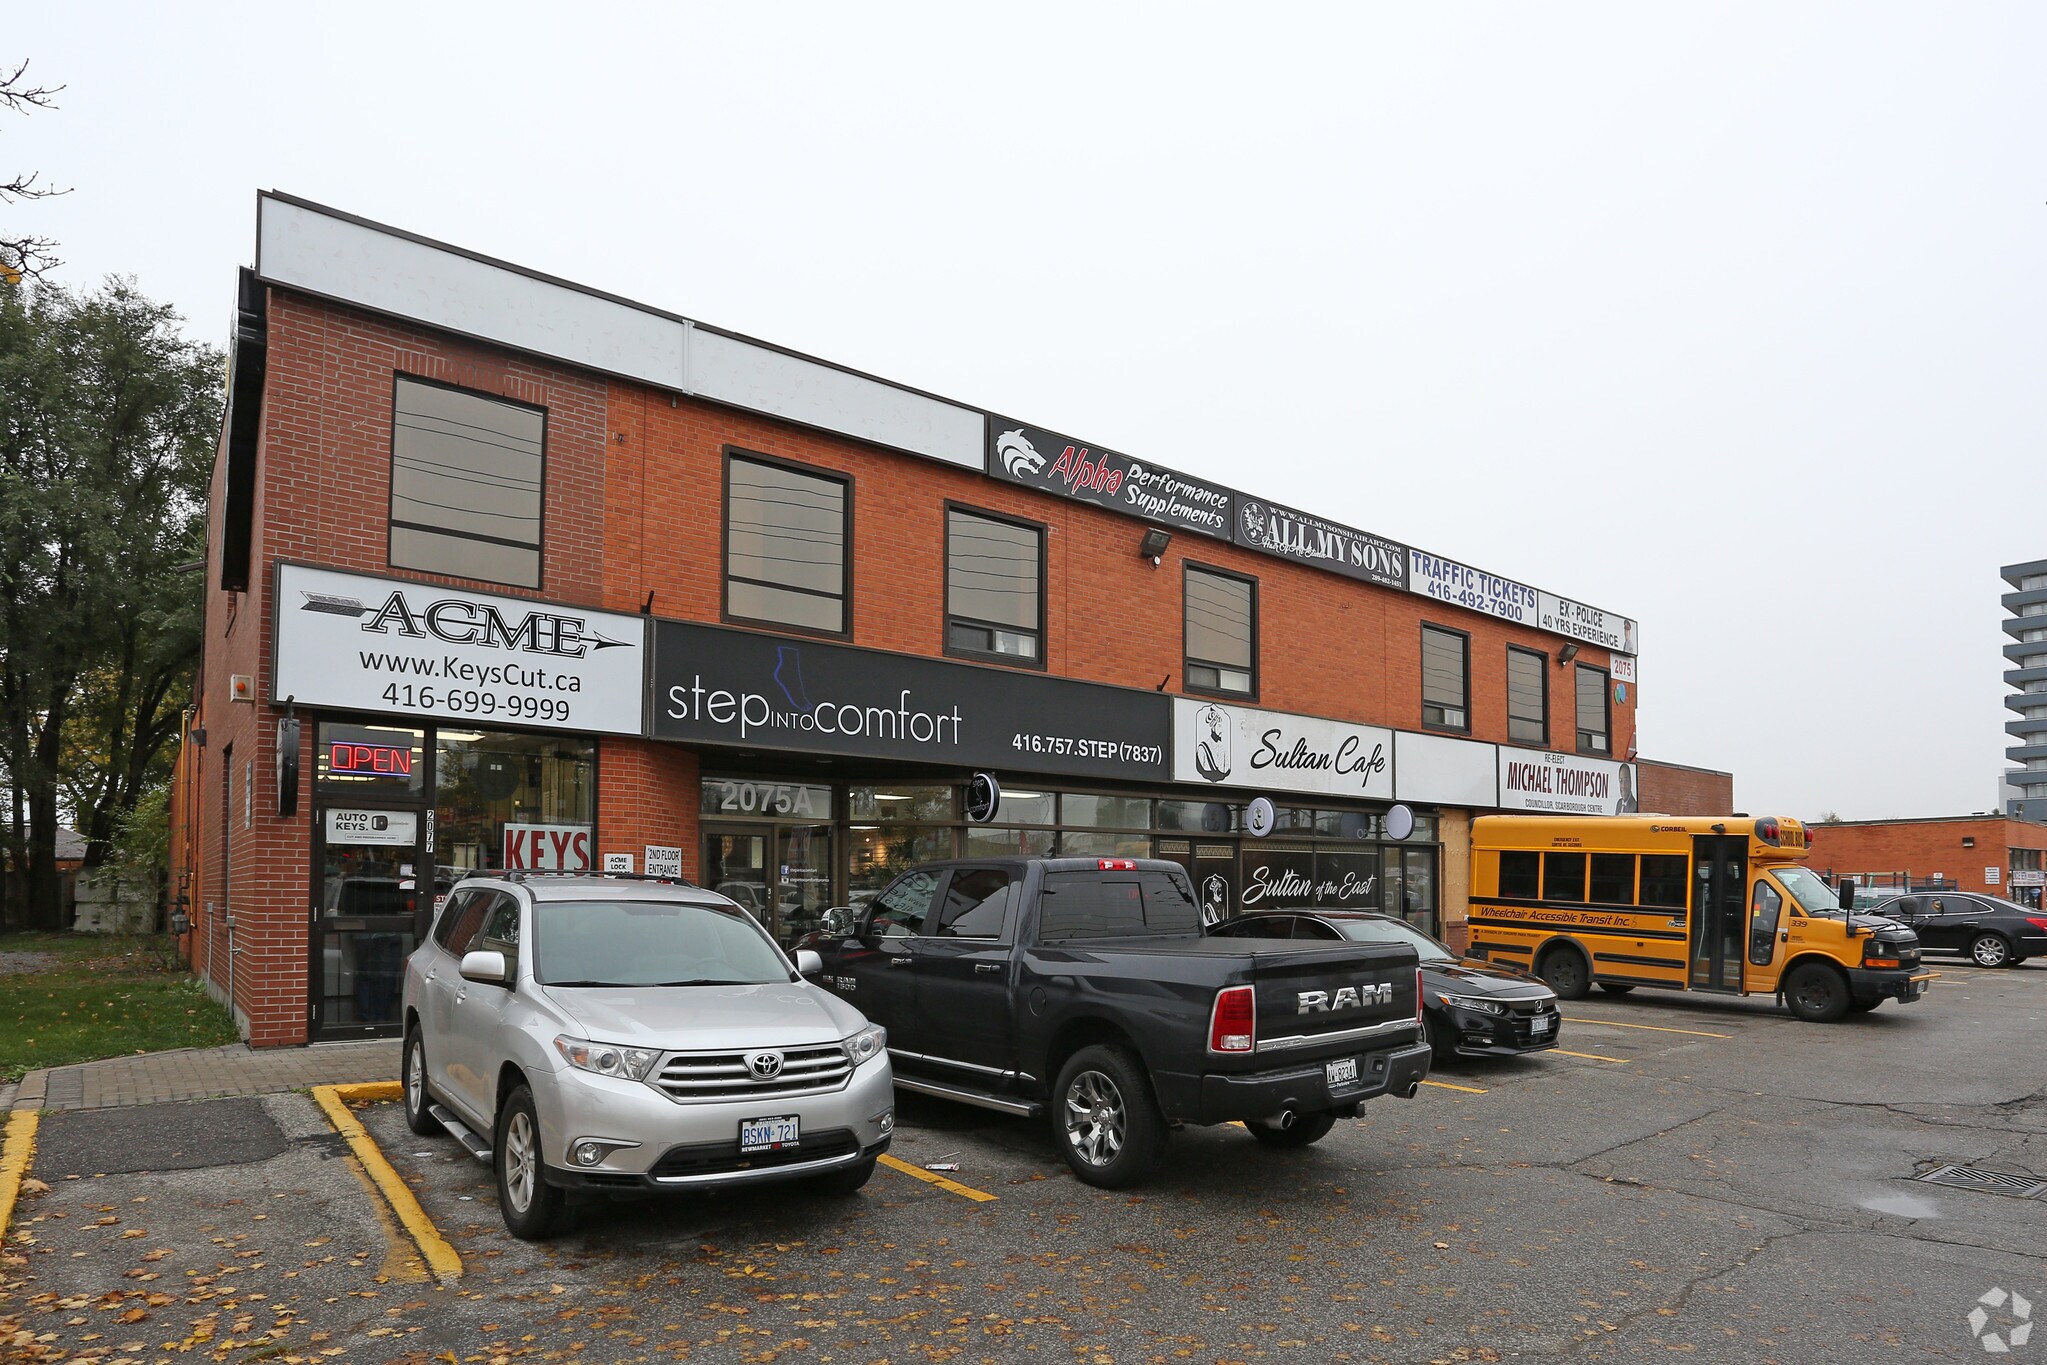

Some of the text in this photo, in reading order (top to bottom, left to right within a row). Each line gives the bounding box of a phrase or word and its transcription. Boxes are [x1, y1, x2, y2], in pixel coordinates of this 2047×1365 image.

[1048, 445, 1123, 496] Alpha
[1124, 463, 1228, 509] Performance
[1125, 484, 1225, 529] Supplements
[1267, 515, 1403, 578] ALL MY SONS
[1269, 506, 1401, 552] WWW.ALLMYSONSHAIRART.COM
[1411, 551, 1536, 609] TRAFFIC TICKETS
[1427, 580, 1523, 621] 416-492-7900
[1559, 600, 1571, 617] EX
[1576, 607, 1603, 629] POLICE
[361, 590, 587, 659] ACME
[1542, 613, 1619, 648] 40 YRS EXPERIENCE
[359, 651, 581, 693] www.KeysCut.ca
[1614, 658, 1632, 677] 2075
[382, 682, 570, 722] 416-699-9999
[667, 674, 963, 745] step INTO comfort
[331, 744, 411, 773] OPEN
[1012, 733, 1163, 766] 416.757.STEP (7837)
[1250, 728, 1386, 788] Sultan Cafe
[1544, 753, 1565, 765] RE-ELECT
[720, 781, 814, 814] 2075A
[1507, 762, 1609, 799] MICHAEL THOMPSON
[336, 813, 368, 822] AUTO
[1525, 798, 1603, 814] COUNCILLOR, SCARBOROUGH CENTRE
[336, 822, 369, 831] KEYS.
[1780, 830, 1803, 847] SCHOOL BUS
[505, 830, 590, 876] KEYS
[648, 864, 678, 875] ENTRANCE
[1242, 866, 1377, 905] Sultan of the East
[1480, 907, 1630, 926] Wheelchair Accessible Transit Inc.
[837, 983, 856, 991] 1500
[1298, 983, 1392, 1015] RAM
[744, 1124, 798, 1145] BSKN 721
